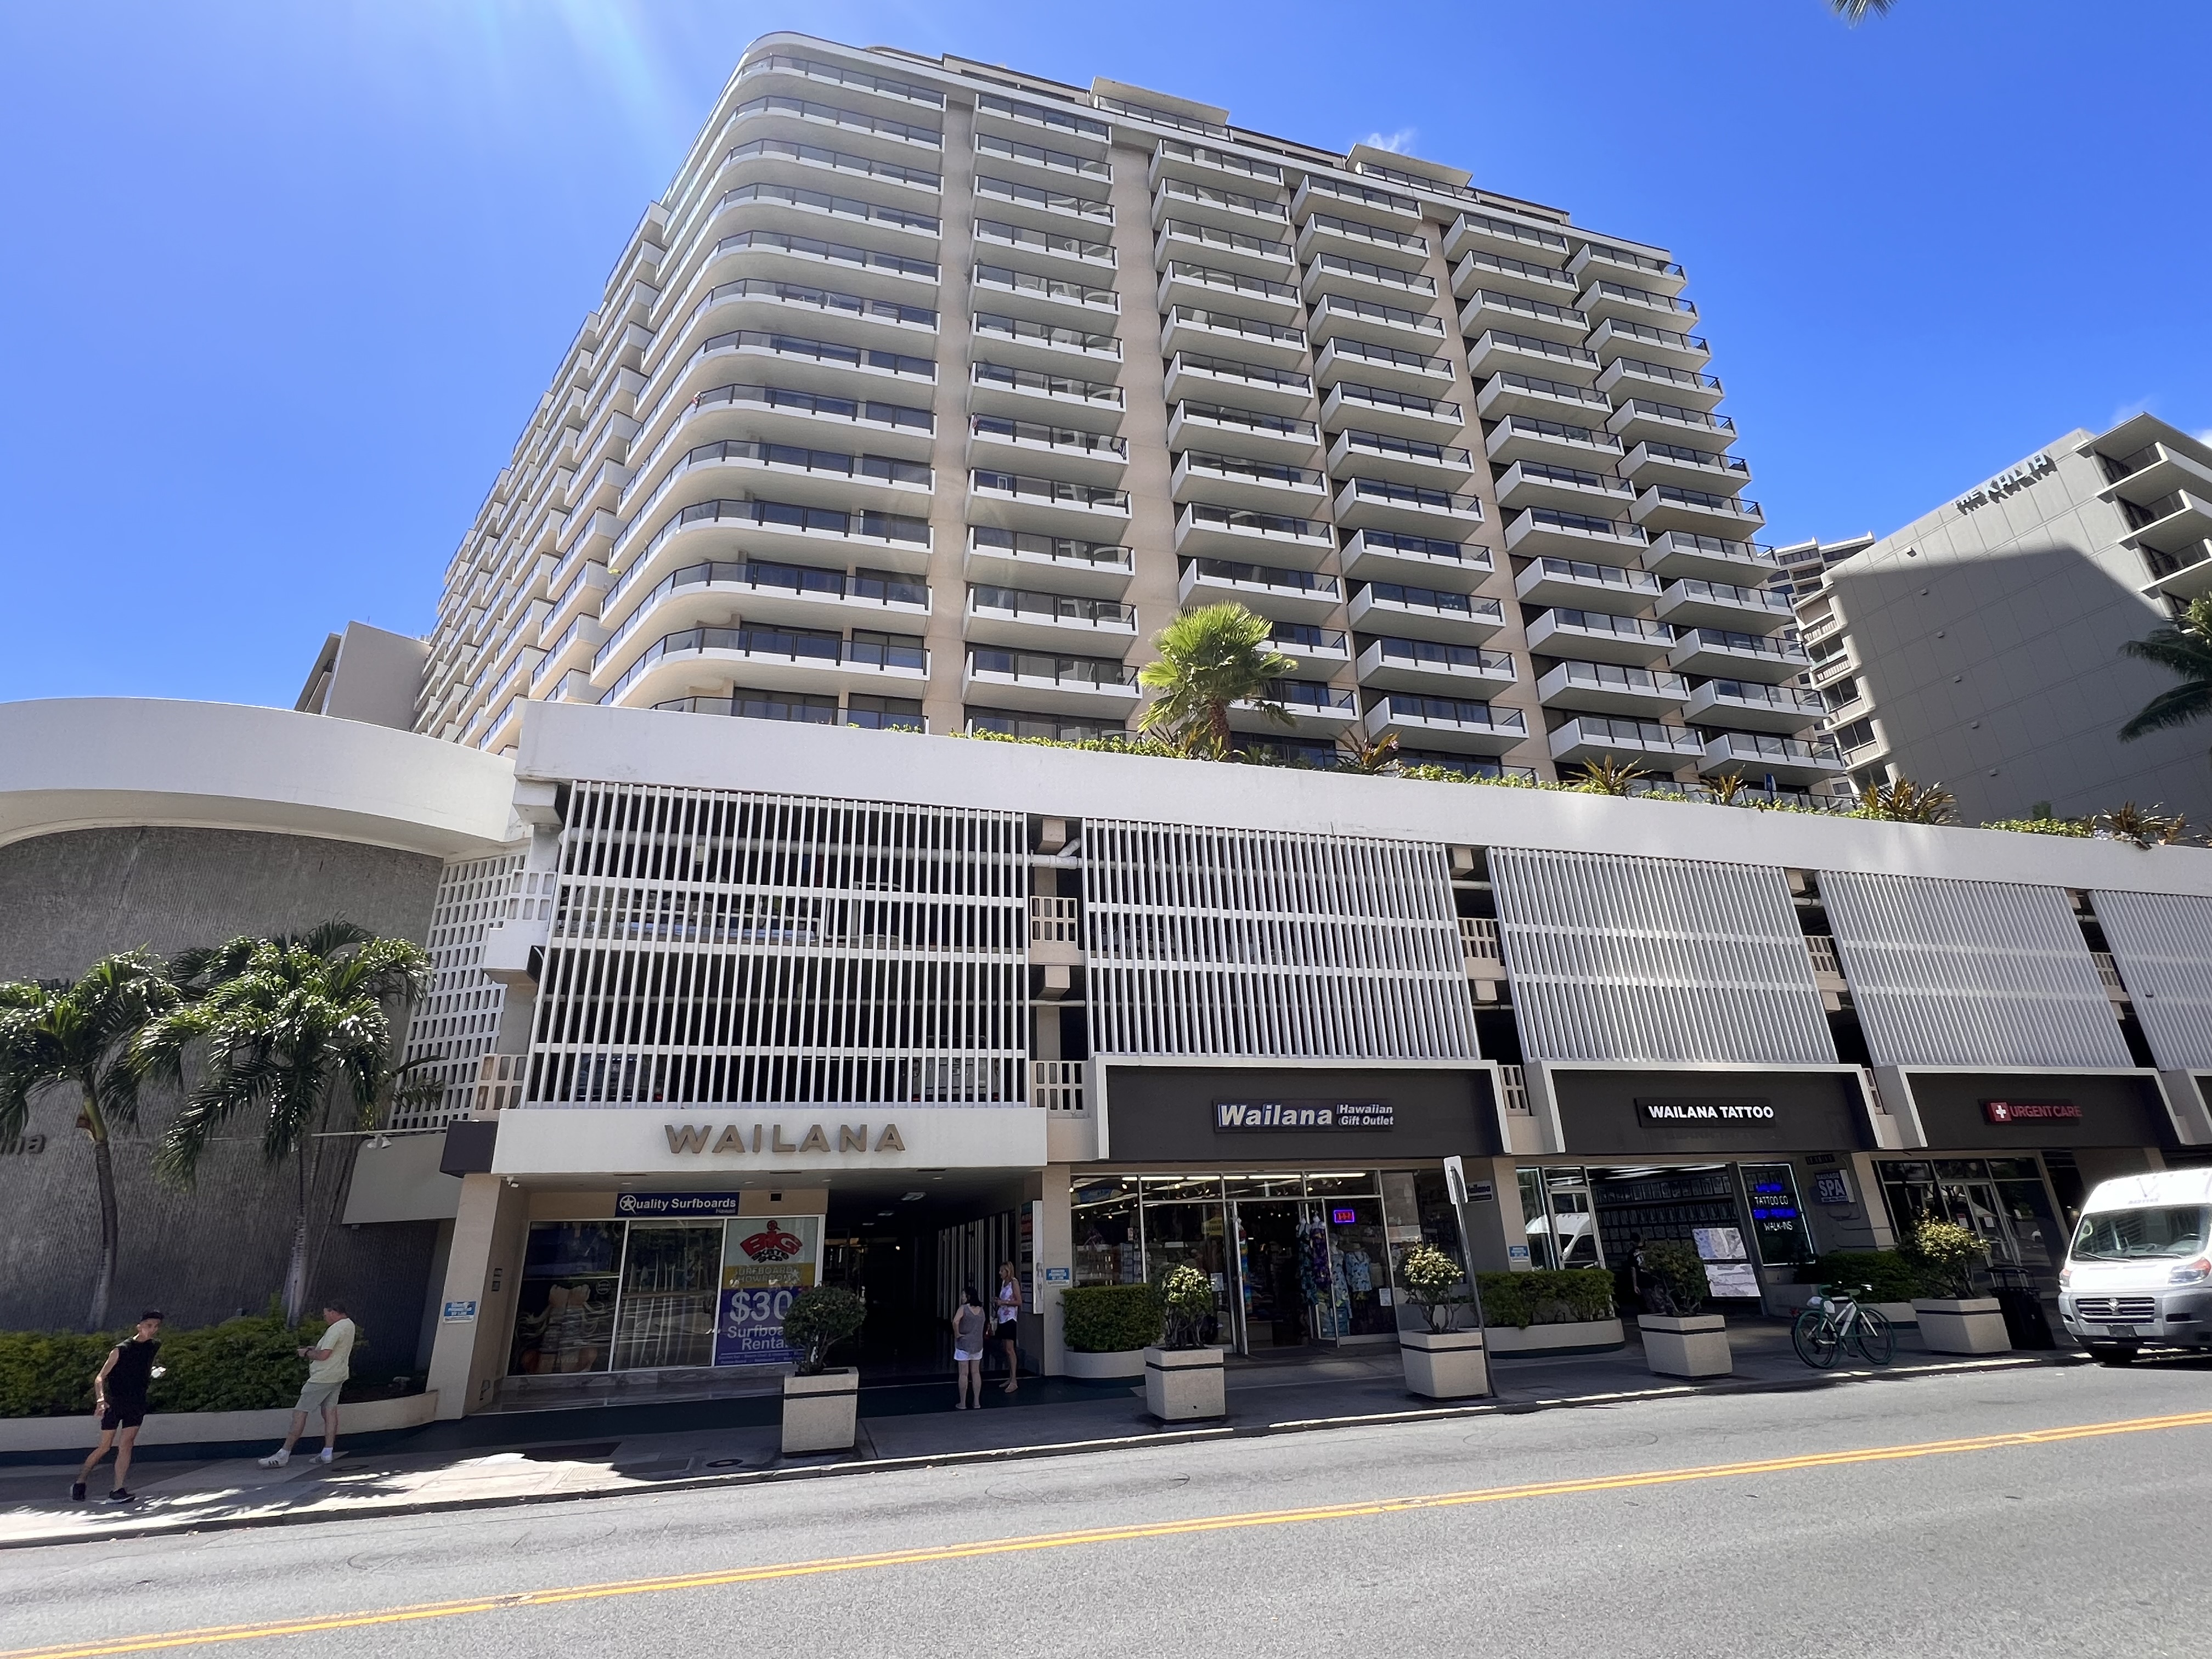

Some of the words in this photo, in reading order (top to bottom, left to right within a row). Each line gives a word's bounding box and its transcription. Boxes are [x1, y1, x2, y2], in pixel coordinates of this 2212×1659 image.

[1982, 452, 2047, 497] KALIA
[1218, 1104, 1333, 1126] Wailana
[1337, 1104, 1393, 1114] Hawaiian
[1648, 1105, 1718, 1118] WAILANA
[1719, 1105, 1774, 1118] TATTOO
[2009, 1105, 2053, 1118] URGENT
[2053, 1105, 2083, 1118] CARE
[1340, 1115, 1360, 1125] Gift
[1362, 1115, 1395, 1125] Outlet
[664, 1123, 906, 1153] WAILANA
[1818, 1179, 1846, 1197] SPA
[619, 1195, 669, 1215] Quality
[671, 1198, 736, 1208] Surfboards
[1754, 1196, 1779, 1205] TATTOO
[1779, 1195, 1789, 1205] CO
[1763, 1221, 1793, 1231] WALK-INS
[740, 1229, 803, 1256] BIG
[730, 1288, 793, 1325] $30
[727, 1324, 785, 1339] Surfboa
[742, 1337, 788, 1351] Renta
